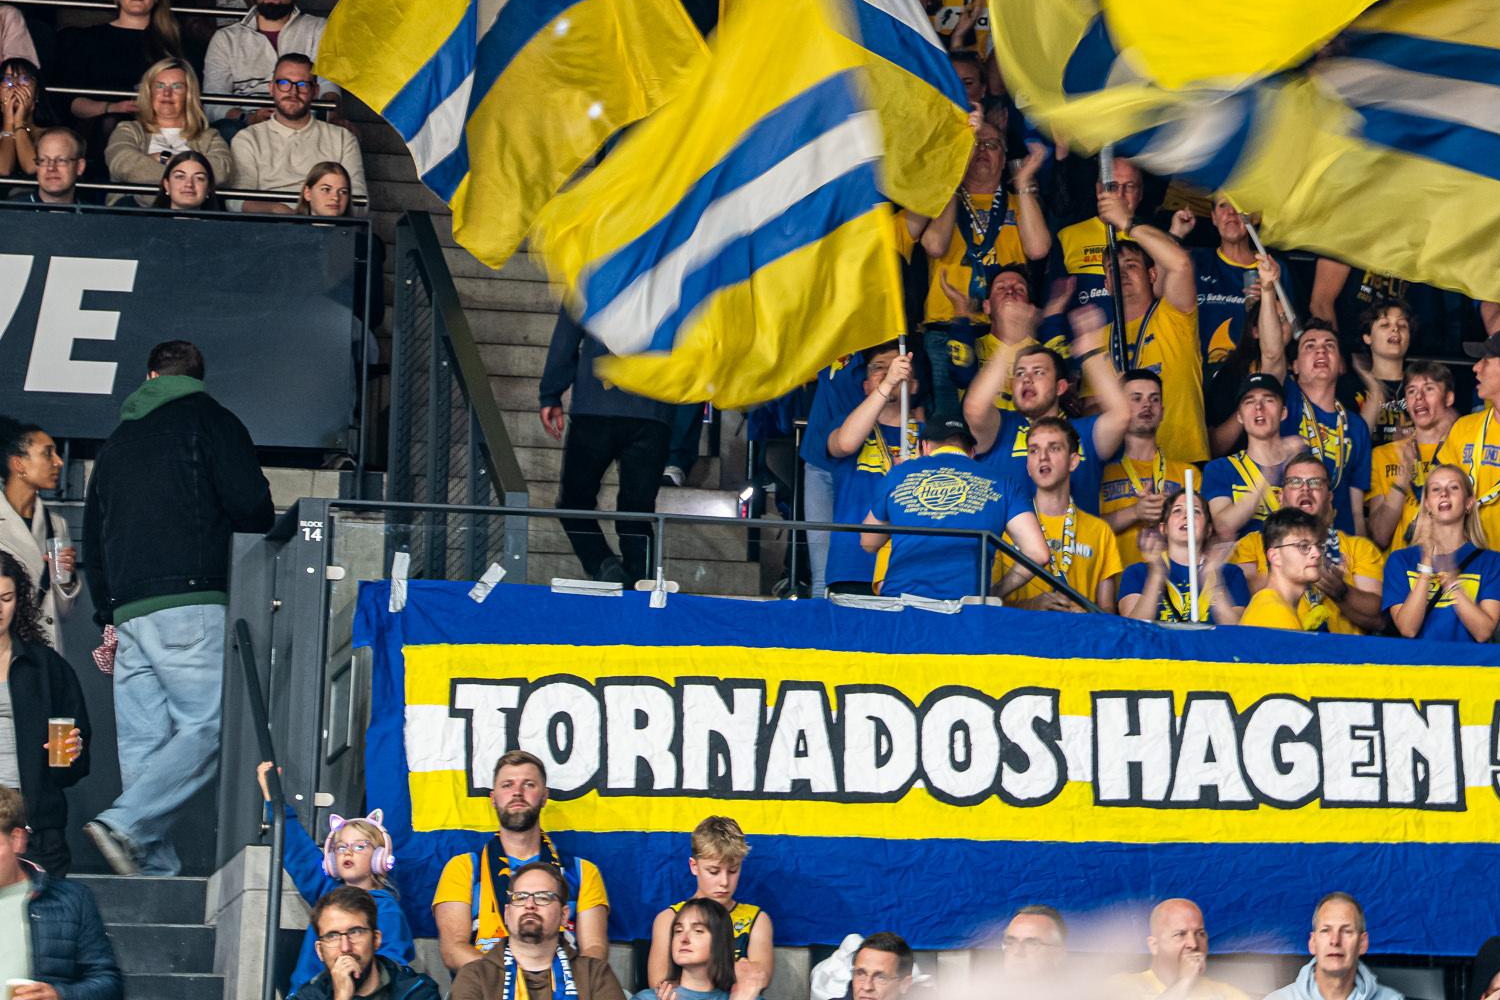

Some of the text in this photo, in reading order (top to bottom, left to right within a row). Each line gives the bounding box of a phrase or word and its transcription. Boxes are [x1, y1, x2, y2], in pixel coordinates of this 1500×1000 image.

[919, 484, 967, 504] Hagen
[299, 520, 324, 528] BLOCK
[302, 527, 323, 542] 14
[450, 674, 1067, 808] TORNADOS
[1089, 690, 1468, 813] HAGEN
